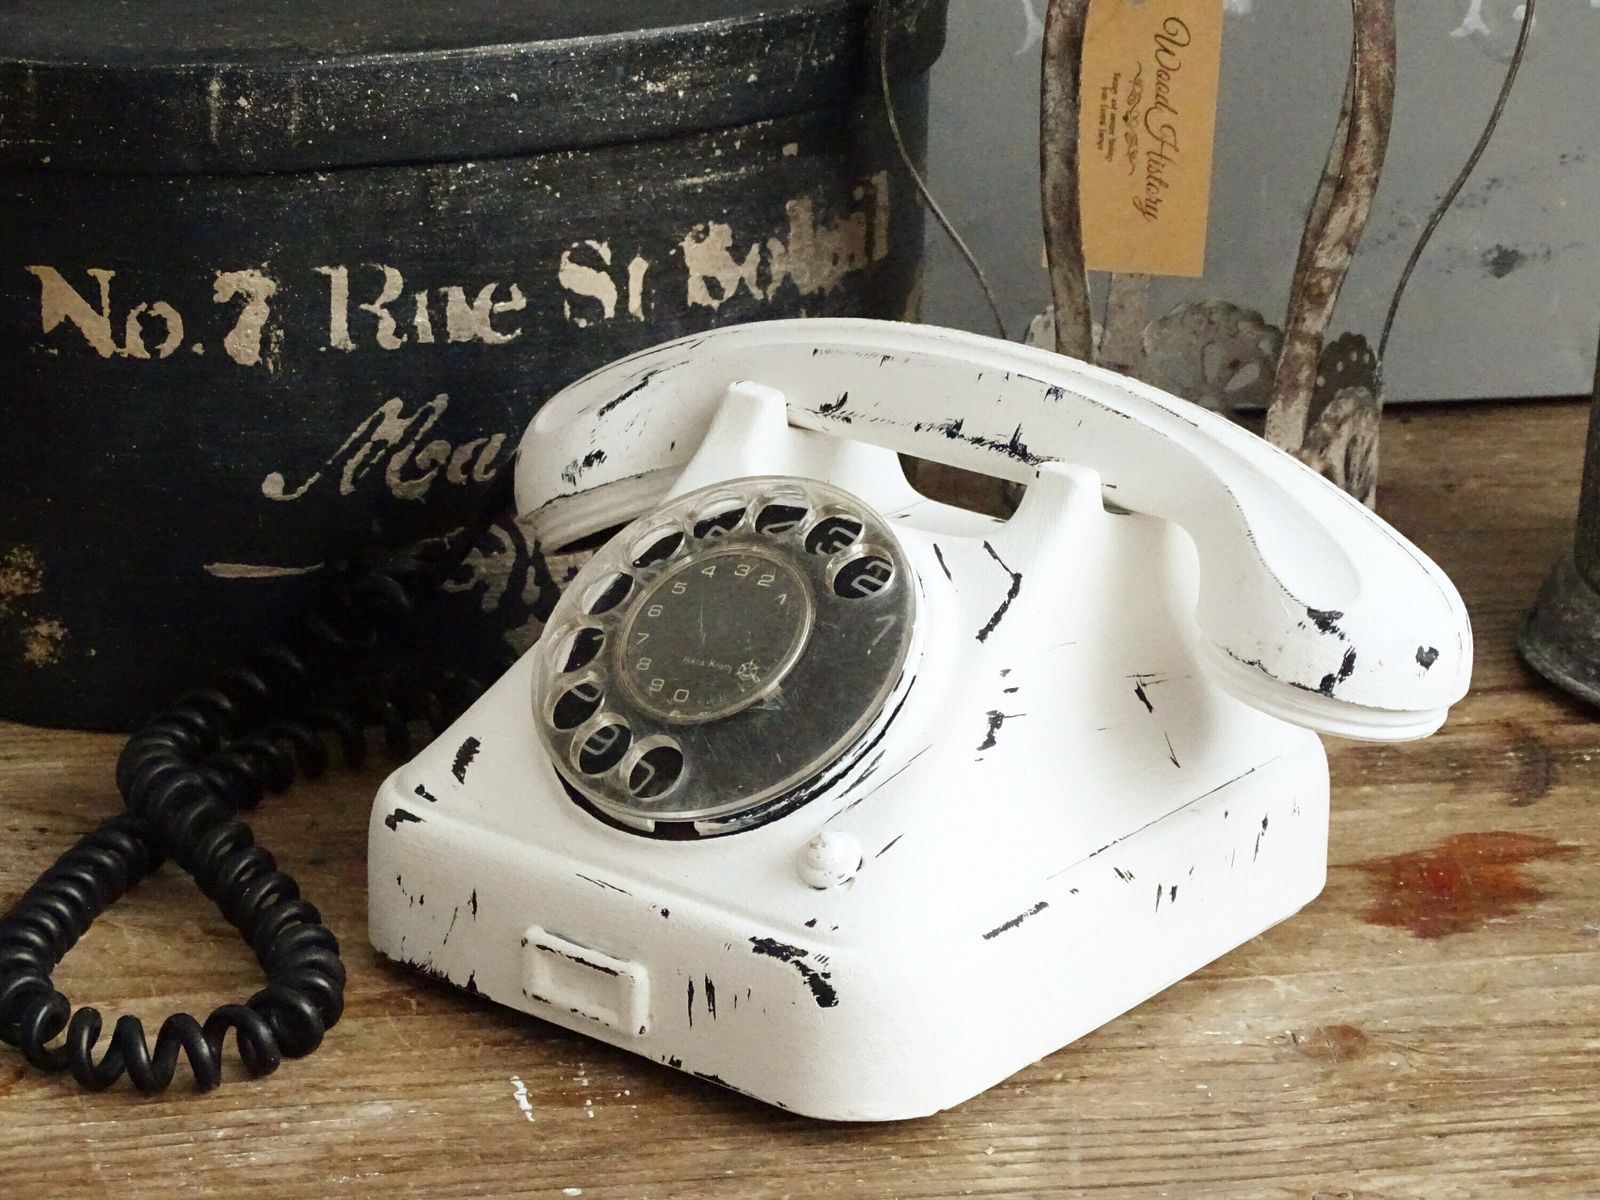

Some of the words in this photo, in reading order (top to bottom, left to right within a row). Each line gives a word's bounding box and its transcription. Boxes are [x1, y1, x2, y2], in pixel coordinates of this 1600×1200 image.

[1132, 106, 1181, 222] History
[311, 264, 527, 351] Rue
[701, 565, 717, 579] 4
[734, 564, 751, 577] 3
[757, 574, 775, 588] 2
[671, 582, 687, 595] 5
[775, 593, 787, 606] 1
[647, 604, 664, 618] 6
[635, 632, 650, 646] 7
[636, 657, 652, 671] 8
[649, 677, 665, 692] 9
[673, 688, 690, 703] 0
